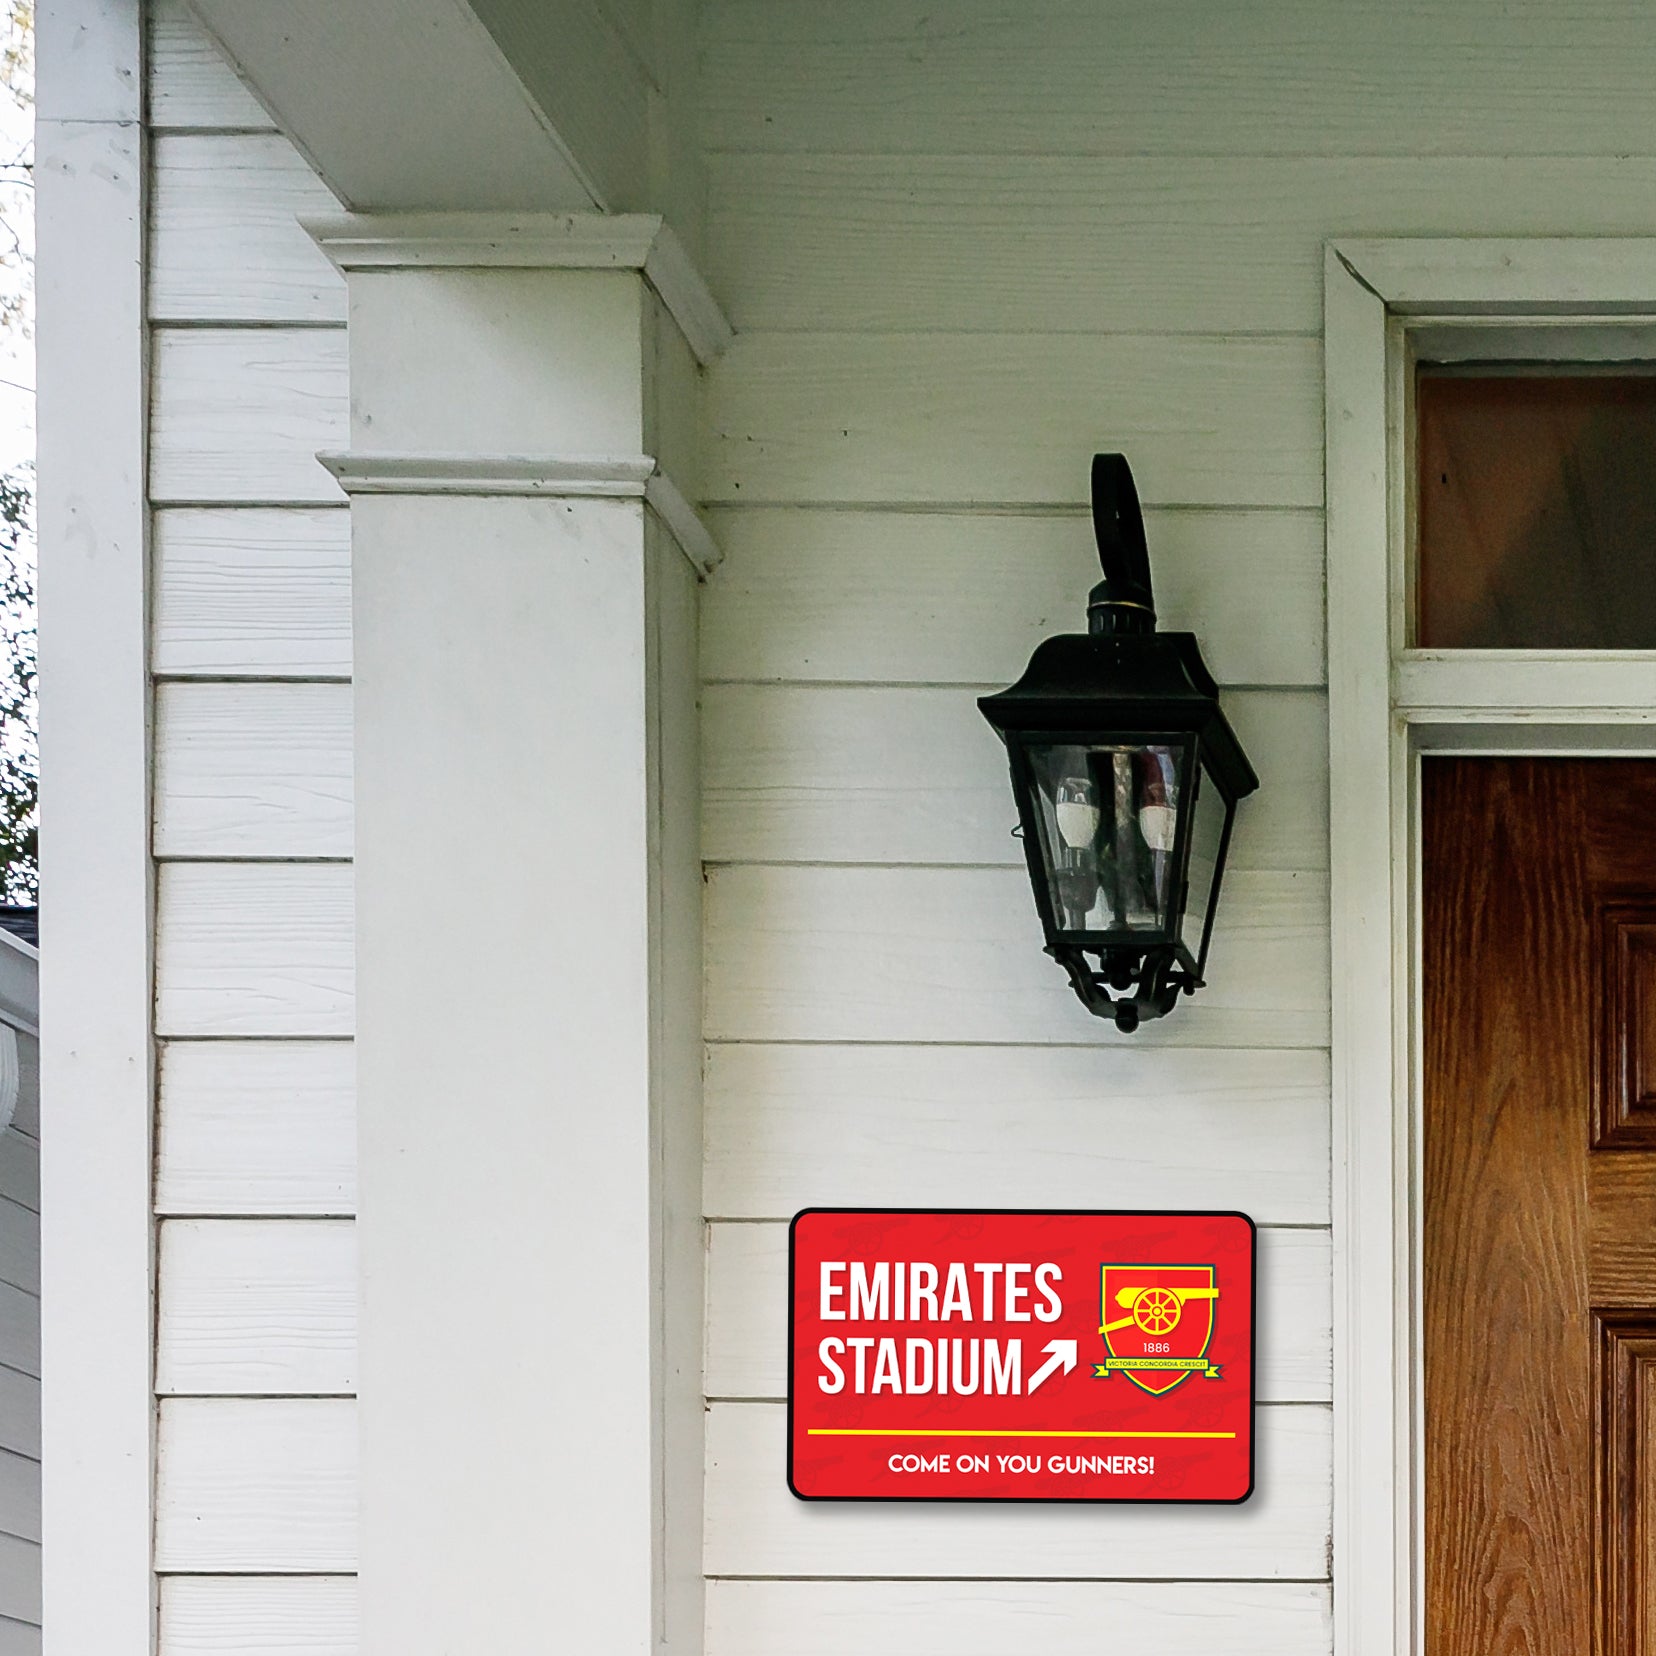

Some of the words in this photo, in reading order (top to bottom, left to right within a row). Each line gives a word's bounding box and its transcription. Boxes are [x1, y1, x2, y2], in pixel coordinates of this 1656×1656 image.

[819, 1262, 1063, 1323] EMIRATES
[817, 1337, 1022, 1396] STADIUM
[1143, 1343, 1170, 1353] 1886
[888, 1455, 951, 1473] COME
[956, 1455, 990, 1473] ON
[995, 1456, 1042, 1474] YOU
[1047, 1456, 1155, 1475] GUNNERS!
